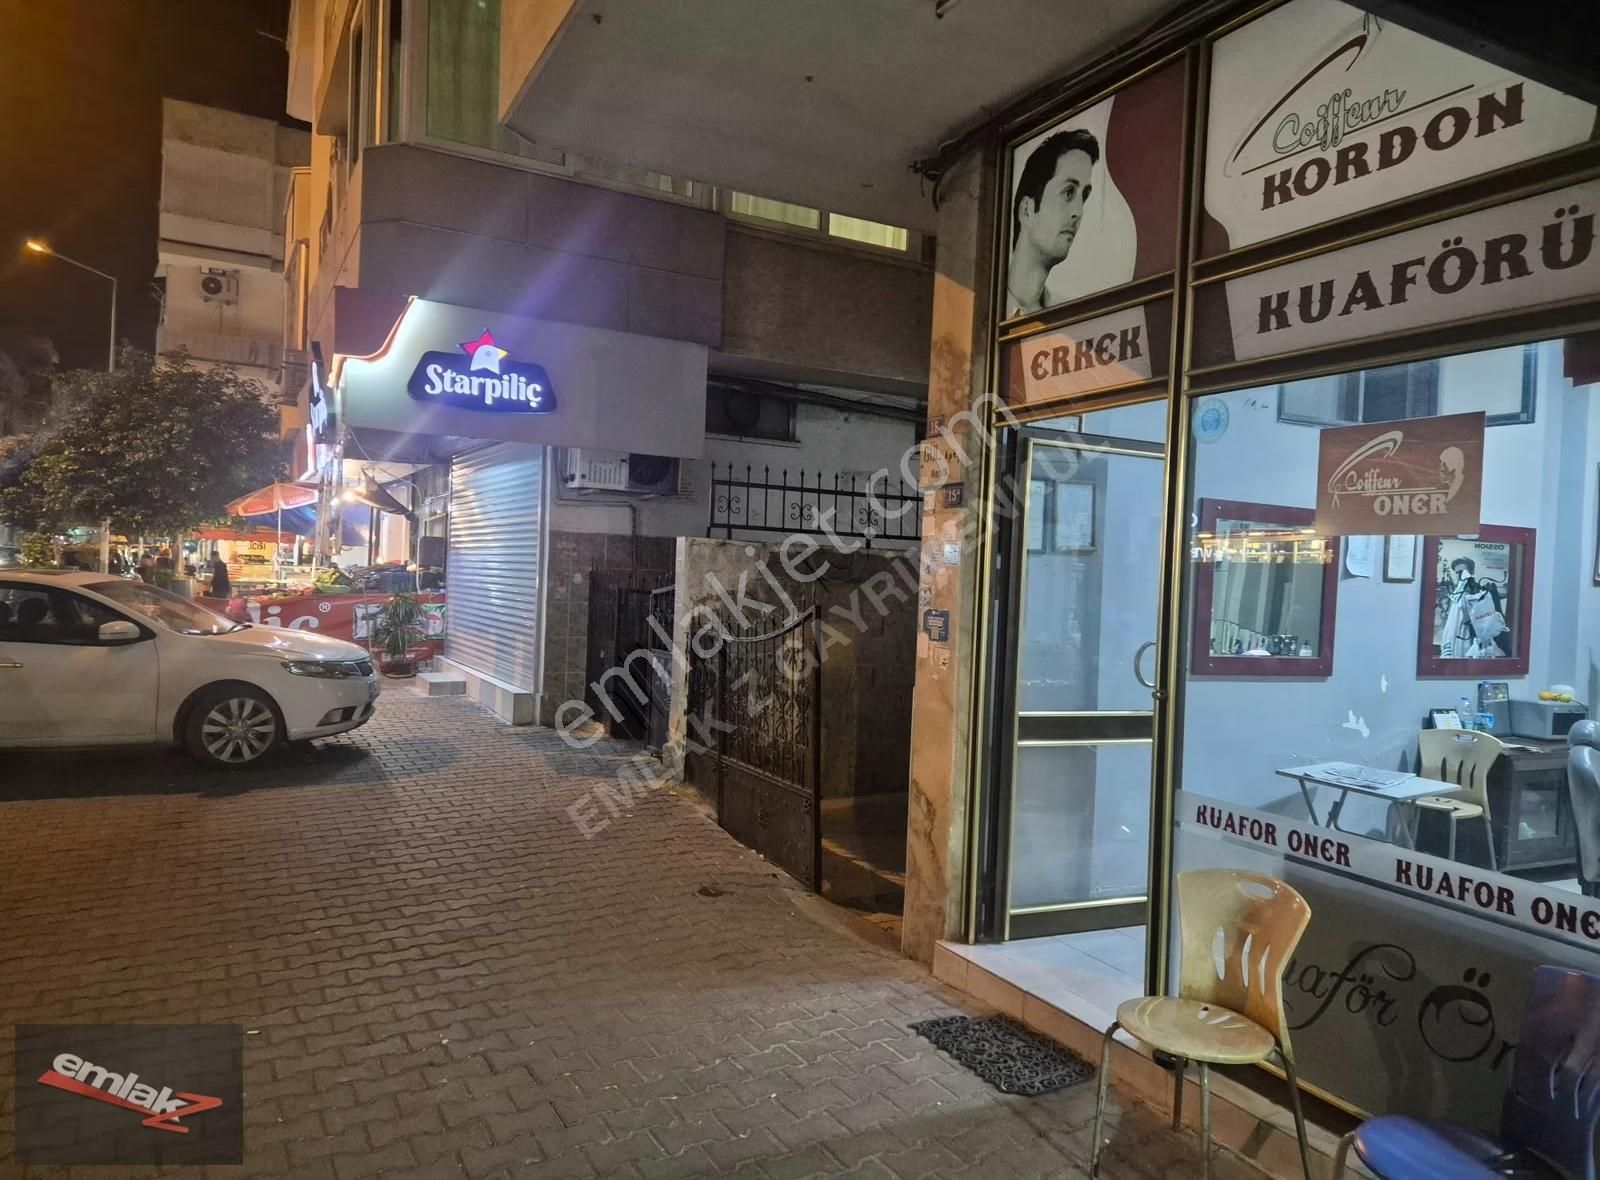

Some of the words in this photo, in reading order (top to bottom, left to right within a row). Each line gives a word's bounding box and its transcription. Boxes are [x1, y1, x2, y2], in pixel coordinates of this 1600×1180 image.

[1260, 81, 1525, 211] KORDON
[1272, 88, 1407, 154] Coiffeur
[1257, 203, 1597, 334] KUAFÖRÜ
[1029, 325, 1142, 381] ERKEK
[424, 363, 542, 408] Starpiliç
[1344, 467, 1403, 497] Coiffeur
[1373, 493, 1448, 517] ONER
[1196, 804, 1278, 846] KUAFOR
[1287, 829, 1352, 868] ONER
[1395, 858, 1517, 917] KUAFOR
